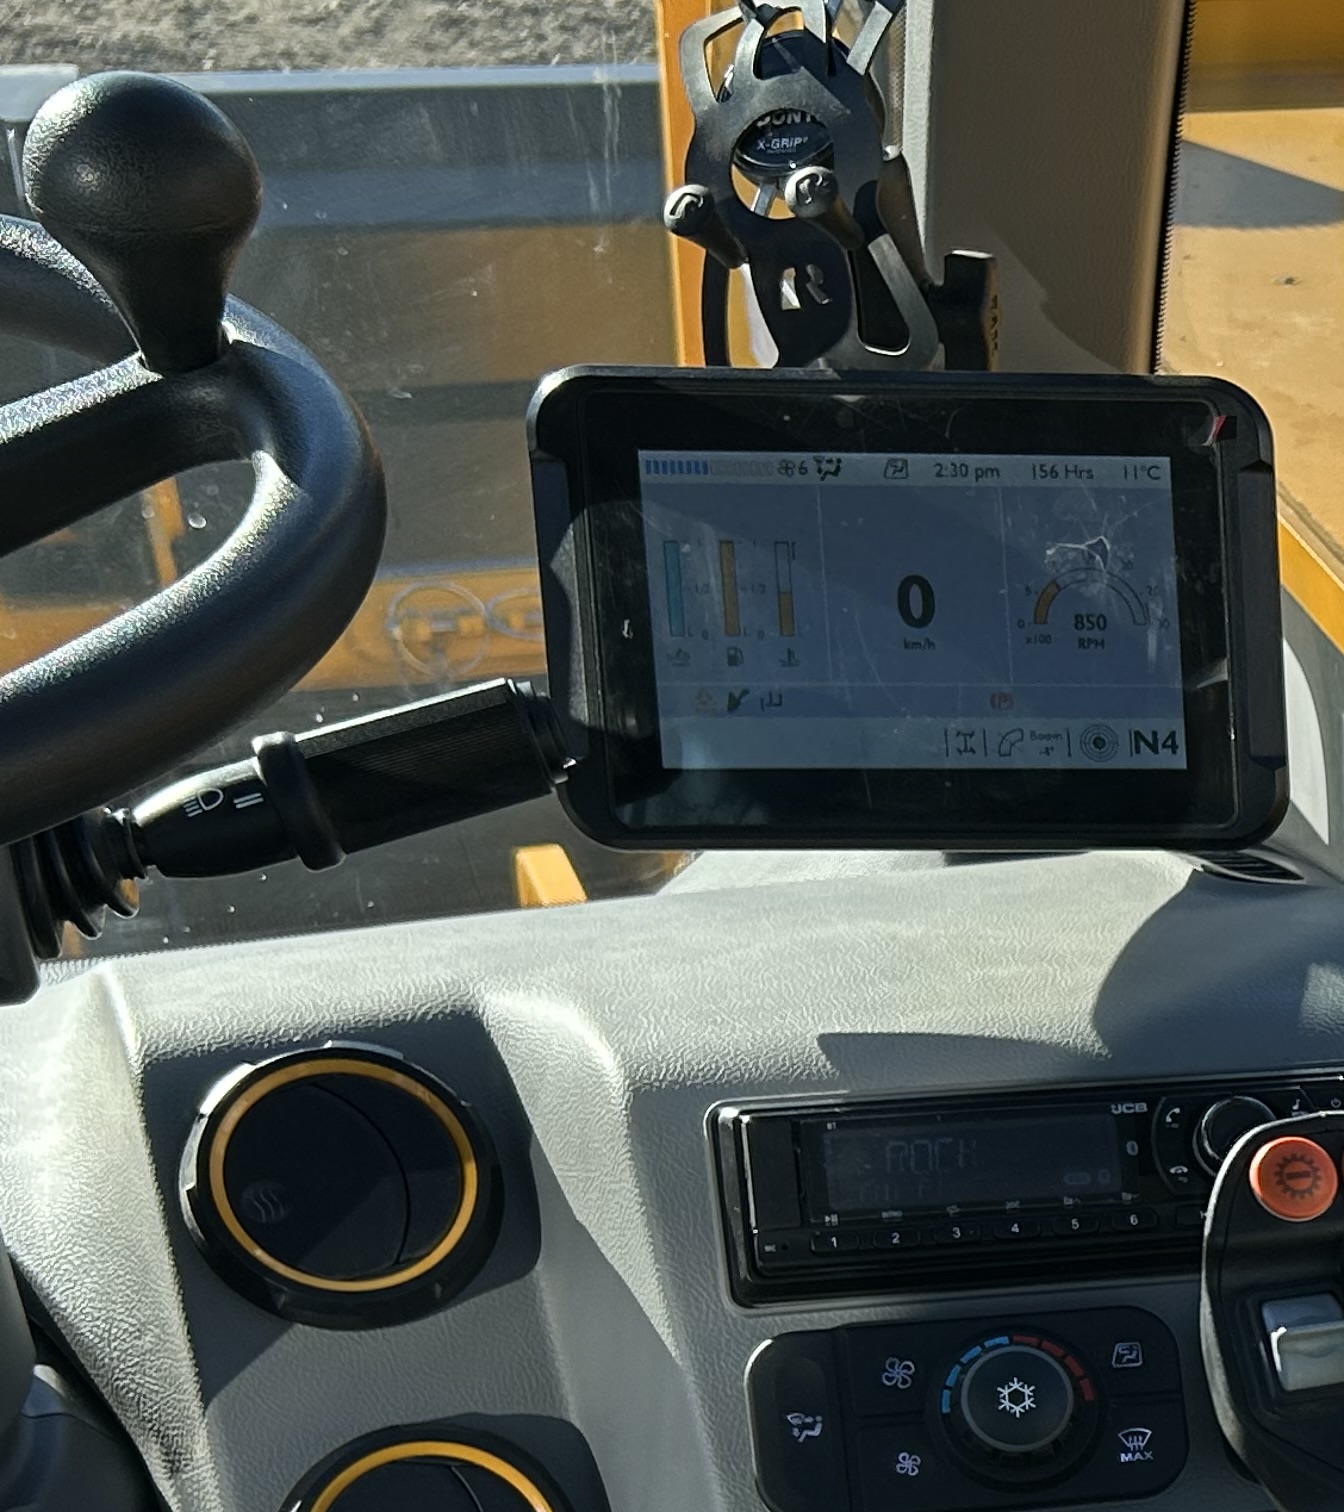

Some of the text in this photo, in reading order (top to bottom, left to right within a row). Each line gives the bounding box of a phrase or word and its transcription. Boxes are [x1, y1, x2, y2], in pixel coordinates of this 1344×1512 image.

[933, 462, 1001, 483] 2:30 pm
[1031, 463, 1095, 480] 156 Hrs
[896, 574, 936, 629] 0
[1073, 613, 1108, 632] 850
[903, 637, 936, 651] km/h
[1077, 637, 1106, 650] RPM
[1132, 730, 1180, 755] N4
[1110, 1102, 1148, 1115] JCB
[1071, 1217, 1080, 1231] 5
[1129, 1213, 1139, 1227] 6
[952, 1226, 961, 1239] 3
[1011, 1222, 1020, 1235] 4
[891, 1232, 900, 1245] 2
[1120, 1451, 1154, 1463] MAX
